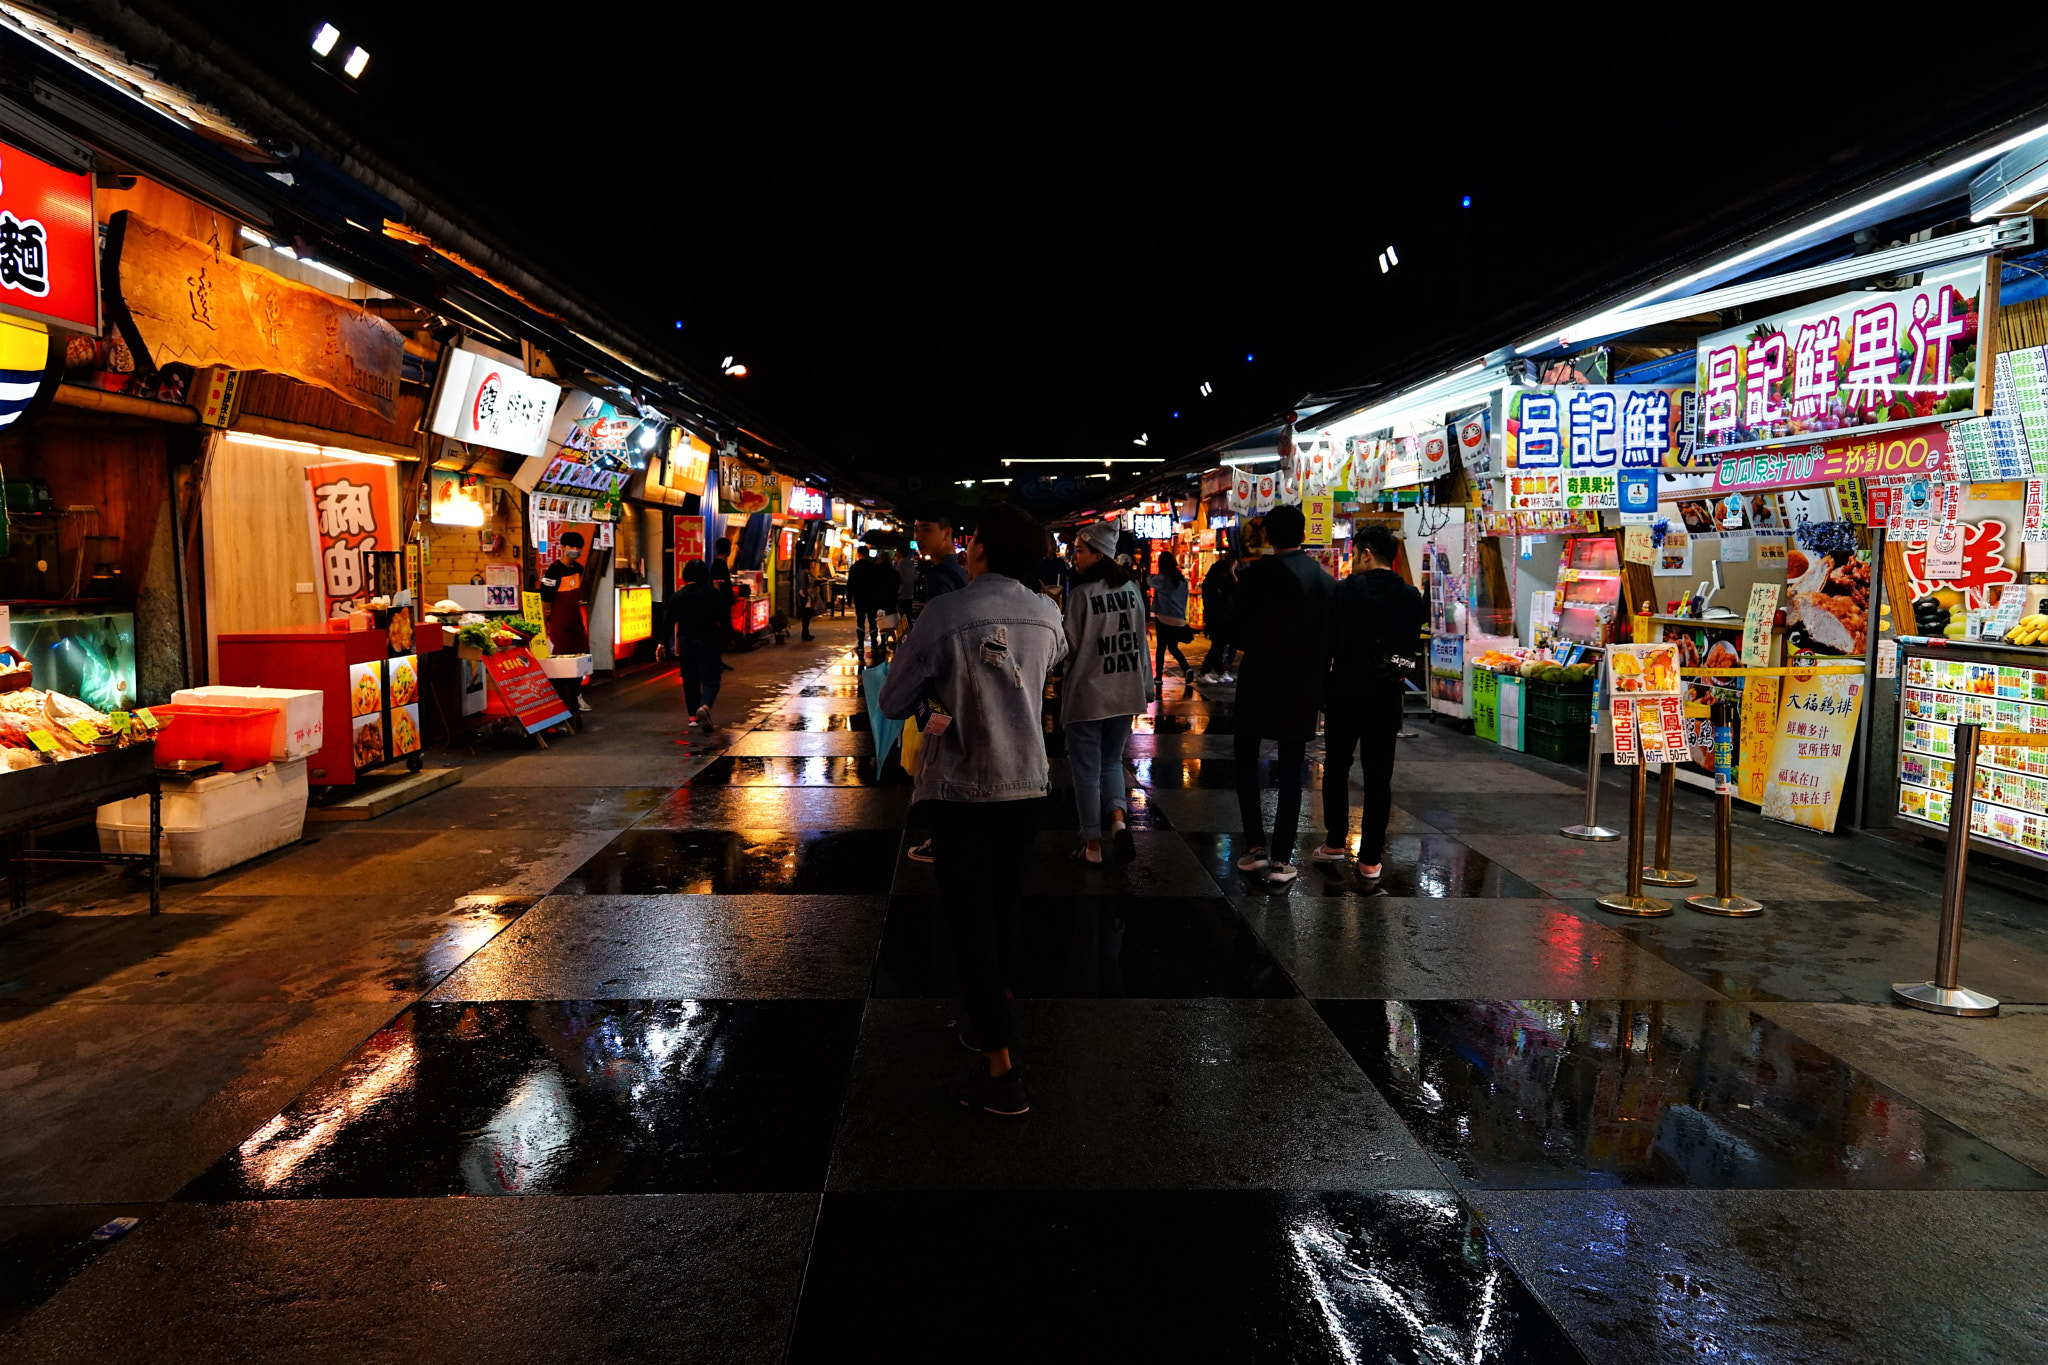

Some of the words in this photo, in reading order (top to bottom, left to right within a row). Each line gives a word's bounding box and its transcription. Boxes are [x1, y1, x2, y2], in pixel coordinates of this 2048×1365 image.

[0, 211, 49, 297] 麵
[1703, 285, 1966, 437] 呂記鮮果汁
[2034, 350, 2042, 359] 30
[2036, 362, 2044, 371] 30
[2038, 374, 2047, 383] 40
[1982, 421, 1989, 430] 50
[1984, 430, 1991, 440] 50
[1824, 445, 1865, 474] 三杯
[1864, 440, 1878, 473] 特價
[1876, 437, 1929, 471] 100
[1989, 449, 1996, 458] 50
[1990, 459, 1997, 468] 50
[1933, 471, 1940, 481] 60
[1993, 468, 2000, 477] 60
[1567, 476, 1615, 495] 奇異果汁
[2025, 480, 2042, 529] 苦瓜鳳梨
[1309, 502, 1325, 541] 買一送一
[2023, 529, 2040, 541] 70元
[1089, 590, 1136, 615] HAVE
[1117, 612, 1130, 632] A
[1103, 651, 1139, 675] DAY
[2021, 670, 2030, 681] 40
[1935, 693, 1956, 705] 西瓜汁
[1636, 697, 1664, 751] 芒果牛奶
[1660, 696, 1683, 749] 奇鳳百
[1786, 720, 1829, 740] 鮮嫩多汁
[1645, 750, 1664, 763] 60元
[1669, 748, 1689, 762] 50元
[1798, 742, 1842, 757] 眾所皆知
[1616, 751, 1636, 765] 50元
[1777, 768, 1820, 788] 福氣在口
[1790, 790, 1831, 805] 美味在手
